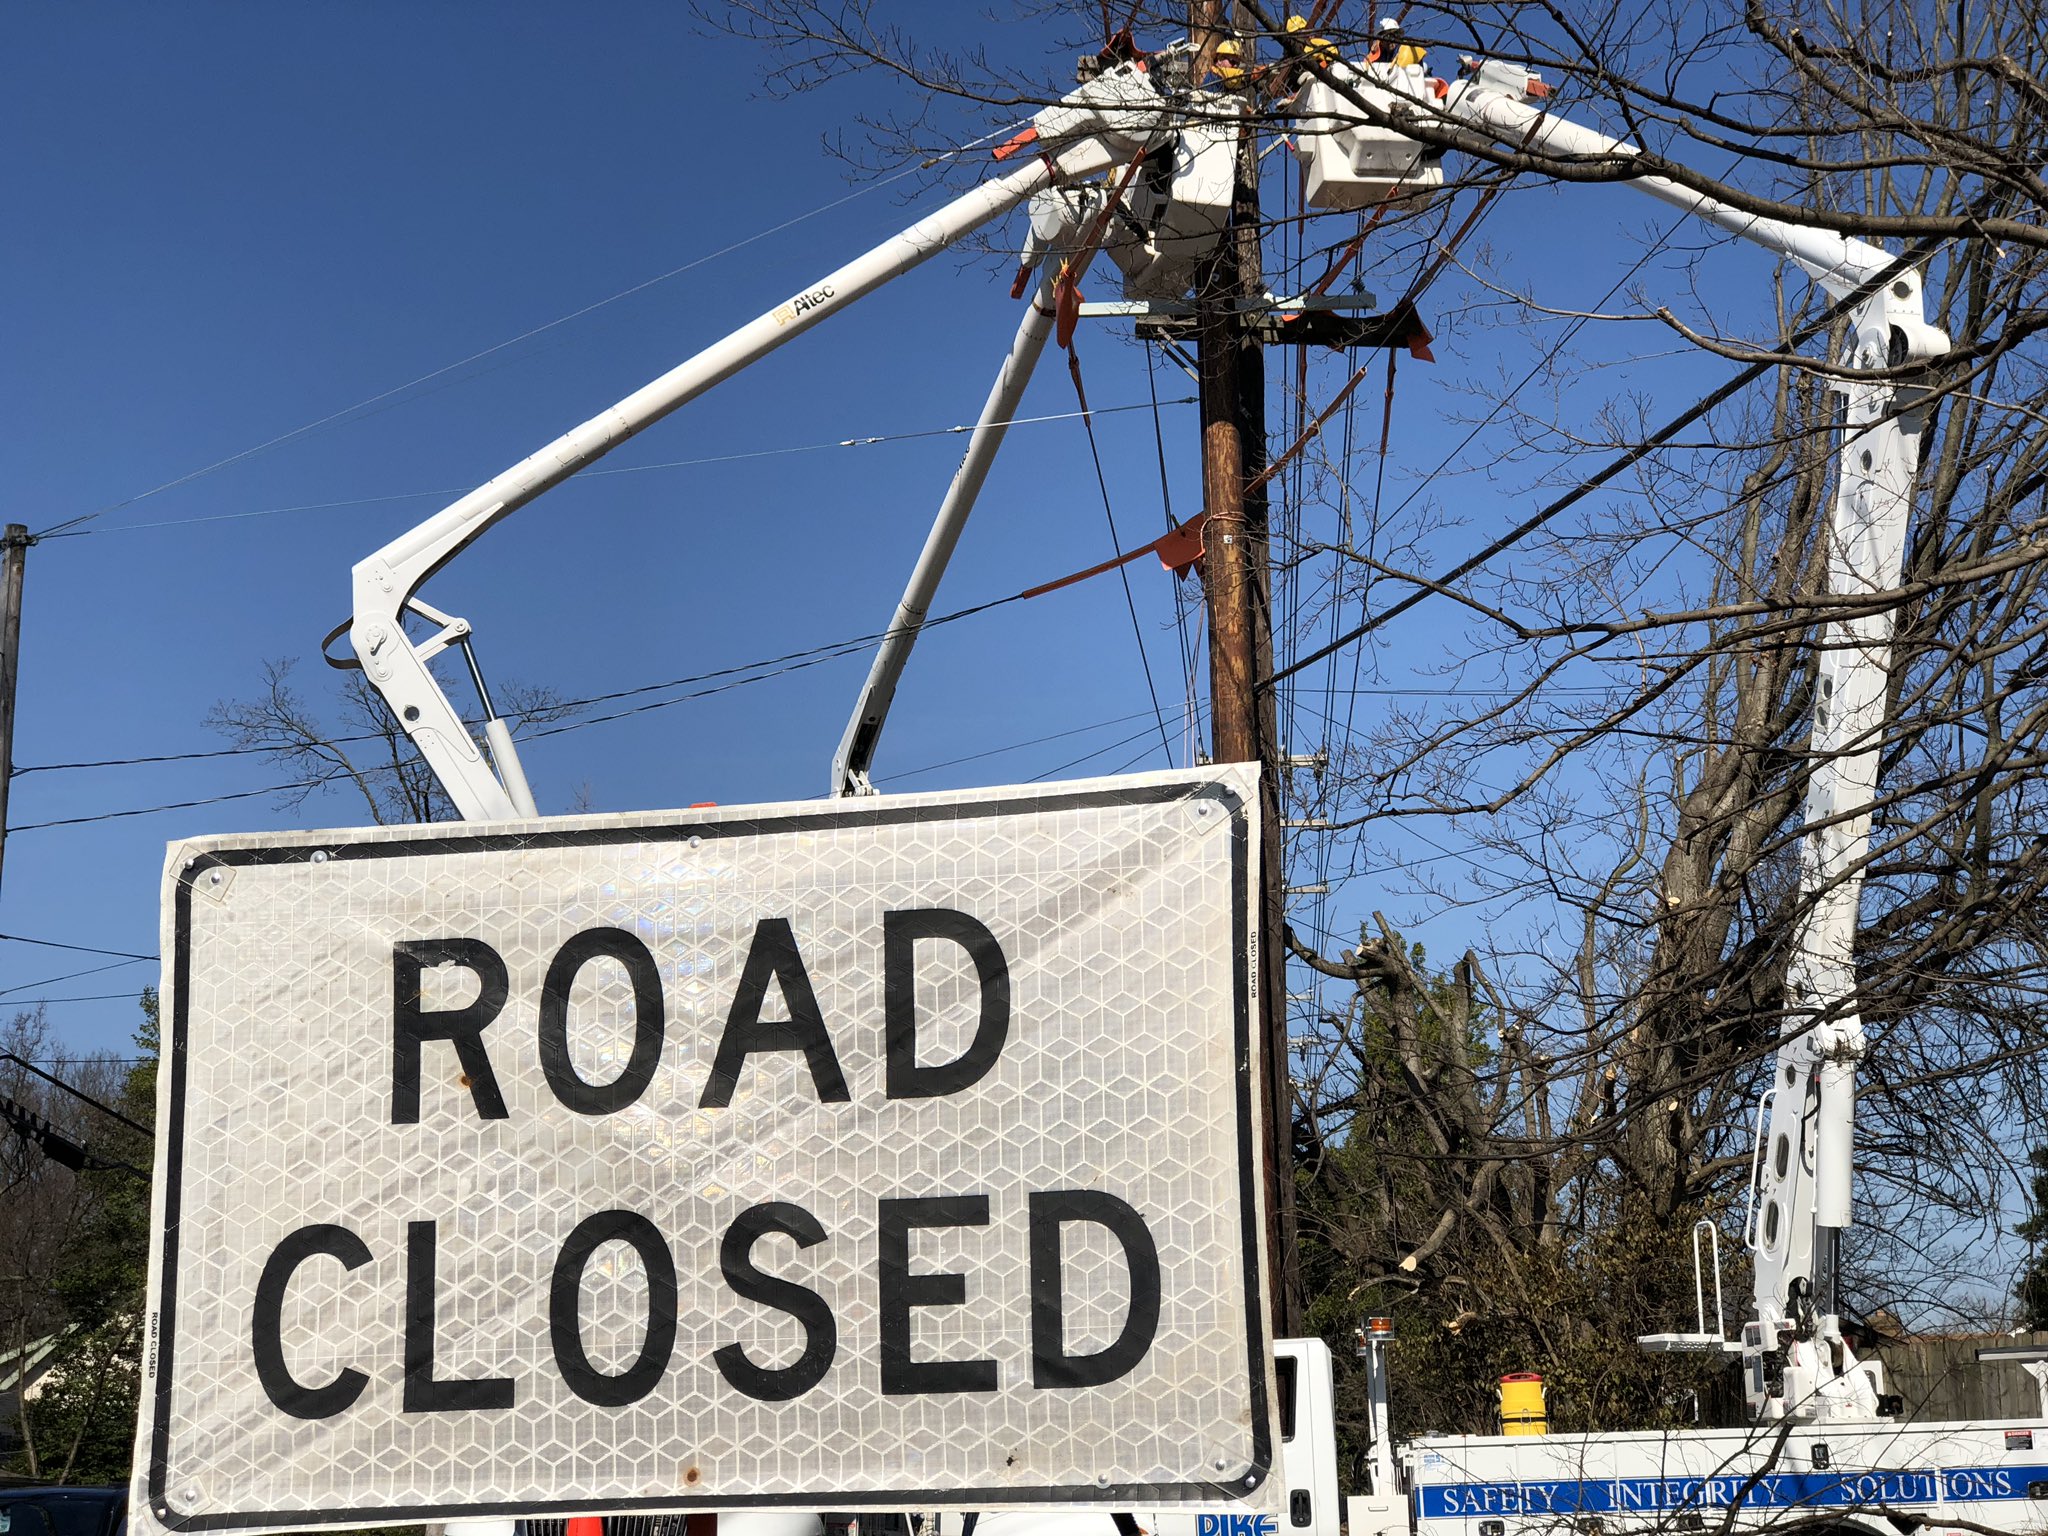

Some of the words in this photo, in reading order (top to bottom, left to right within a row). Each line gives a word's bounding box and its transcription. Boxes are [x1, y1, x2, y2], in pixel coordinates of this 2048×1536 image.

[793, 285, 835, 316] Altec
[392, 908, 1010, 1124] ROAD
[252, 1190, 1160, 1419] CLOSED
[150, 1312, 158, 1338] ROAD
[148, 1341, 157, 1379] CLOSED
[1443, 1485, 1558, 1514] SAFETY
[1606, 1479, 1782, 1509] INTEGRITY
[1840, 1471, 2012, 1501] SOLUTIONS
